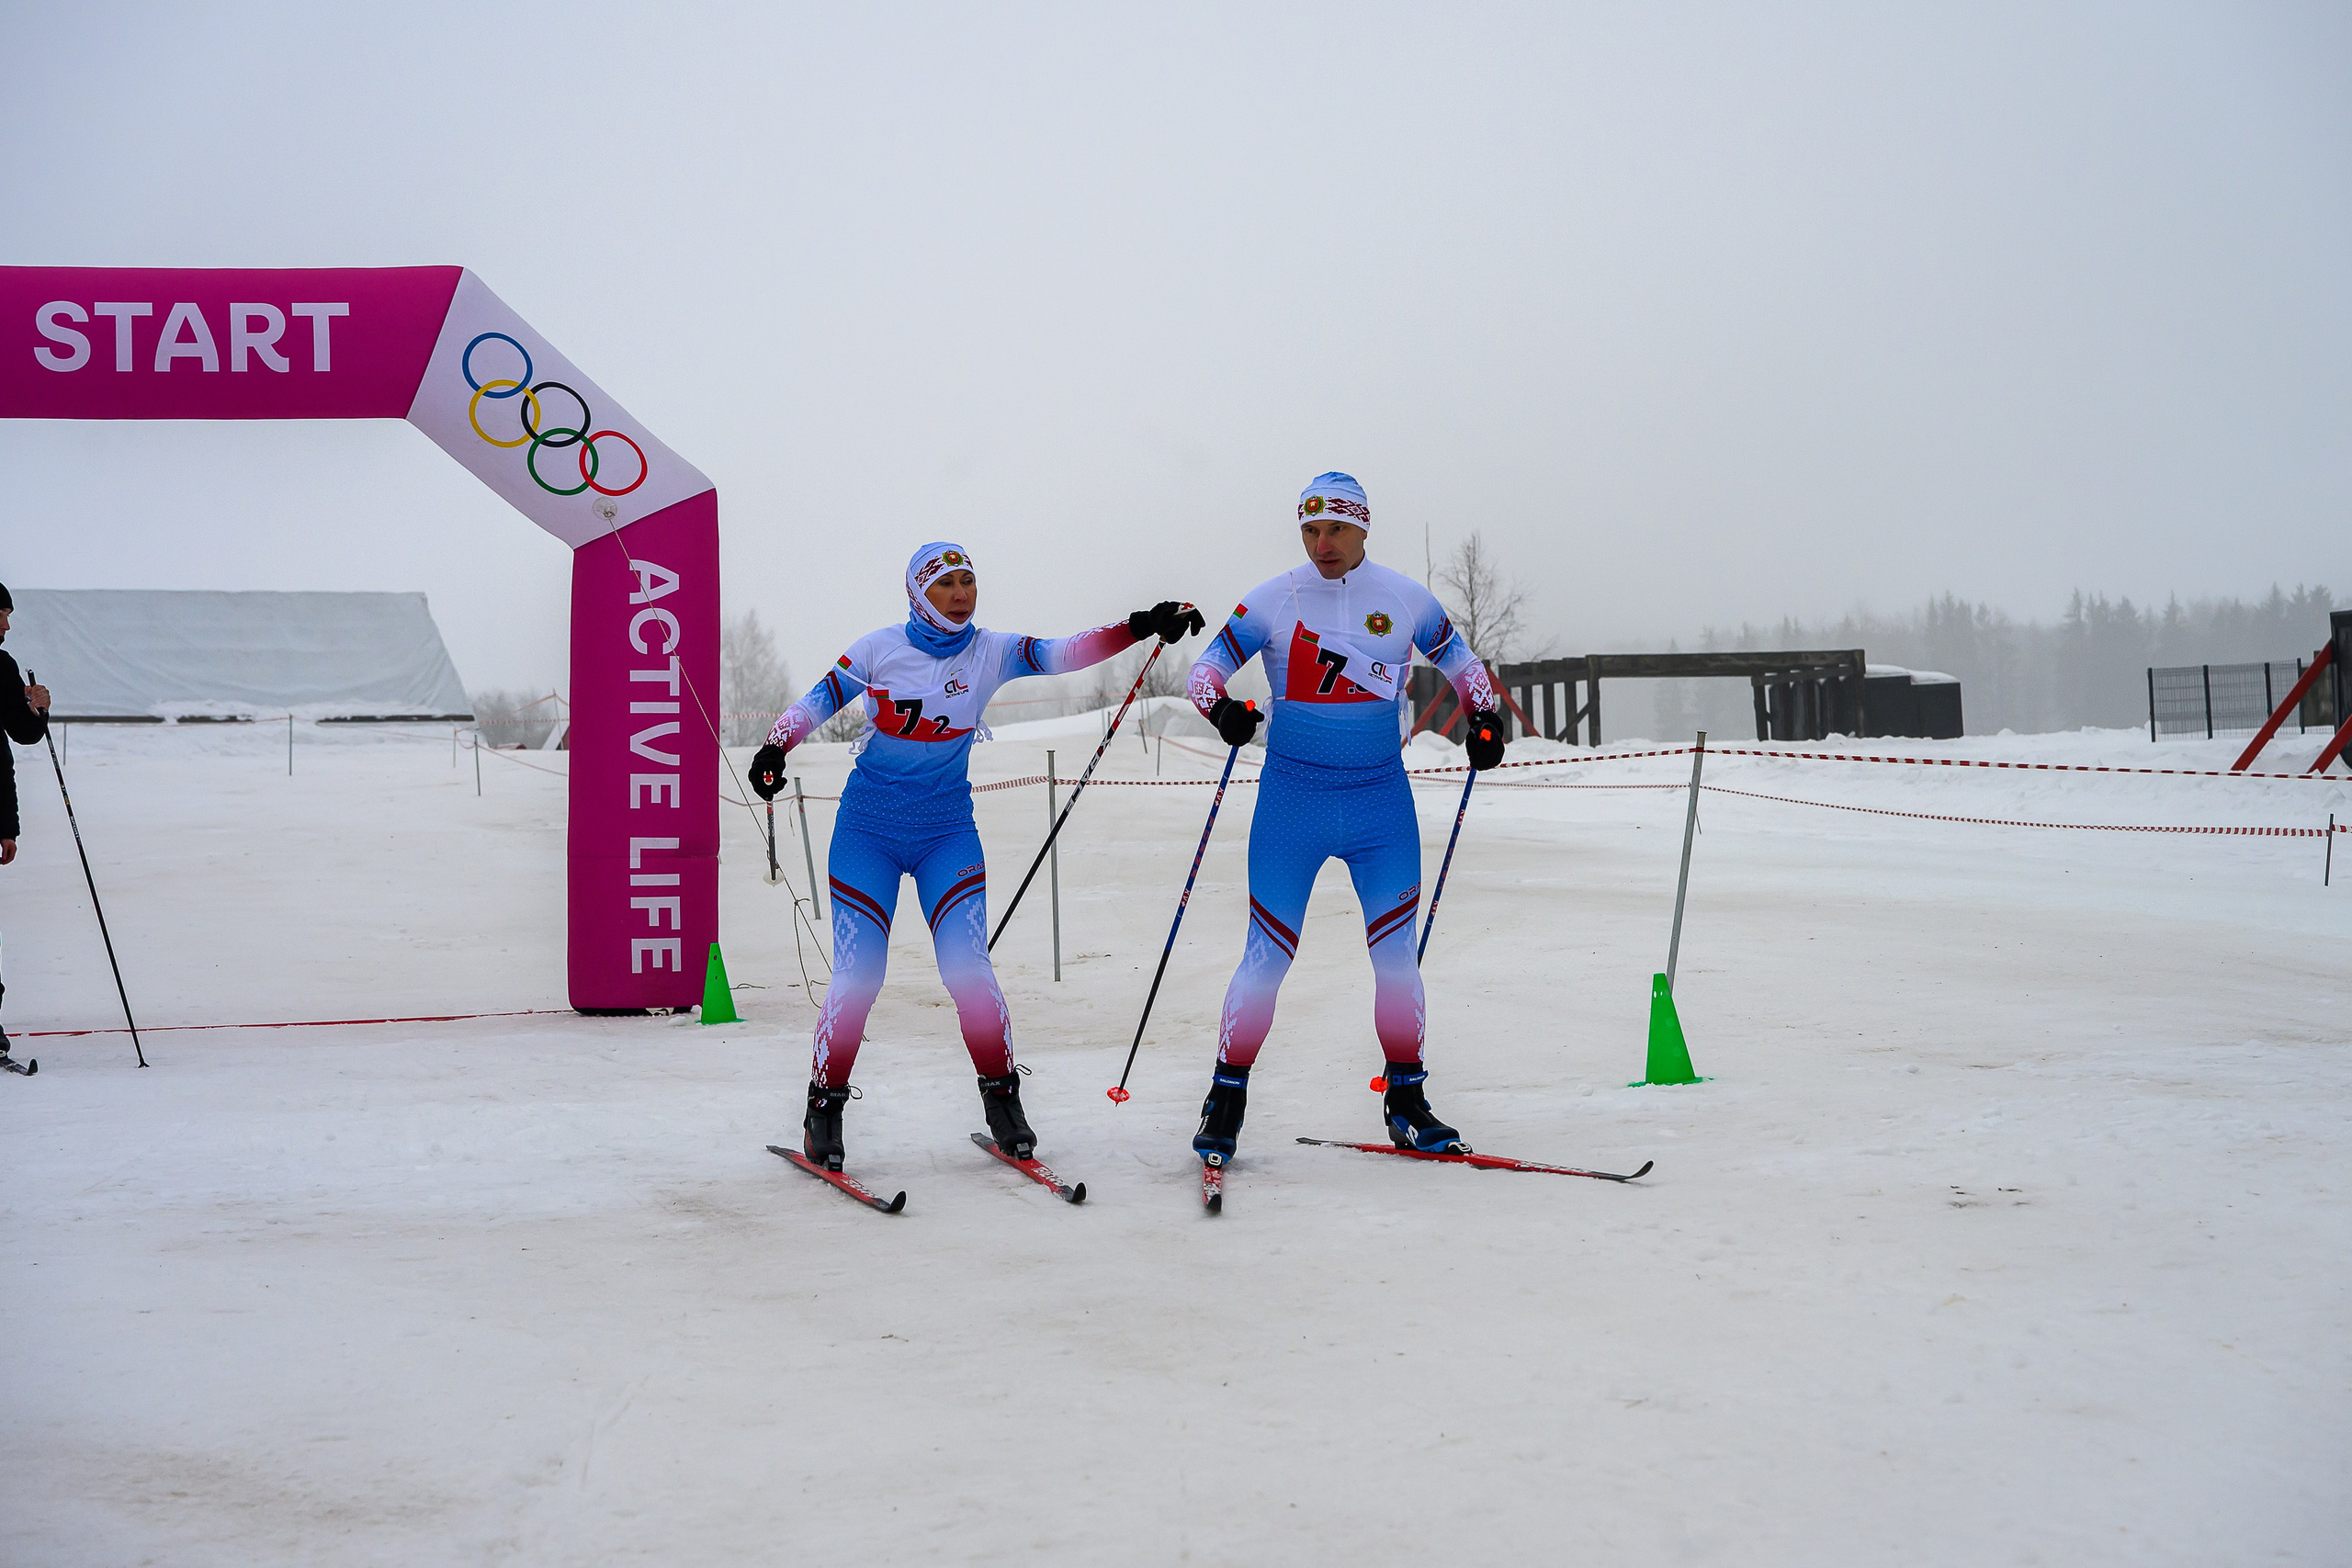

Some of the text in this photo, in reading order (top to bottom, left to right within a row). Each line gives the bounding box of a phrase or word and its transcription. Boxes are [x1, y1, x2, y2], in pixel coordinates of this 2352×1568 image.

[34, 300, 350, 373] START
[893, 698, 951, 735] 7 2
[628, 558, 682, 974] ACTIVE LIFE
[1215, 786, 1225, 807] KV+
[1182, 887, 1191, 908] KV+
